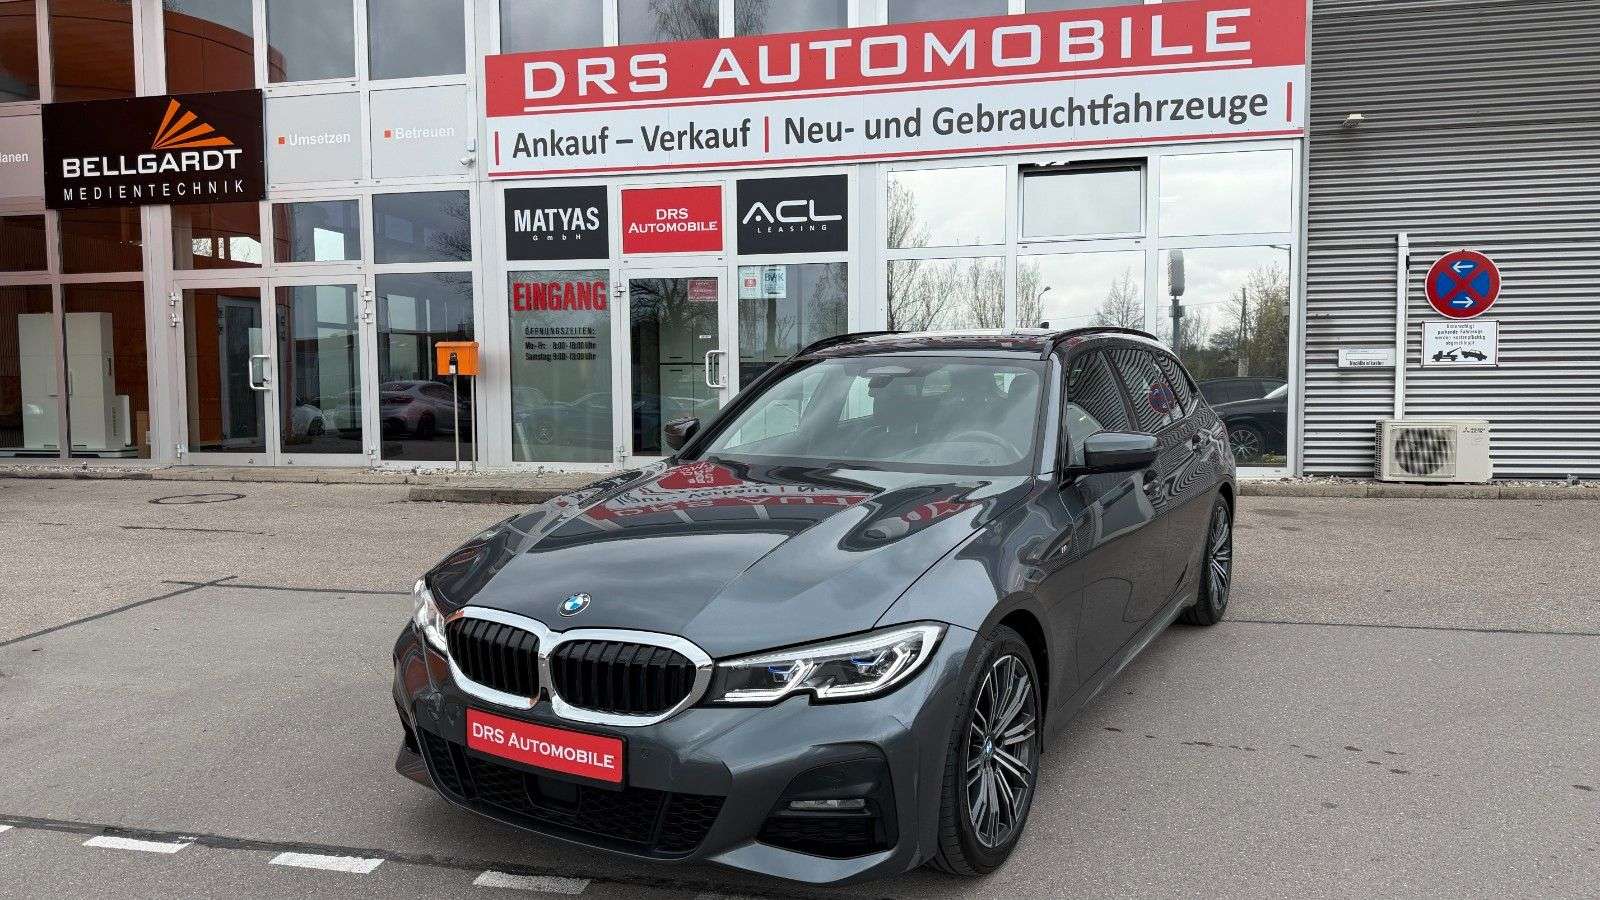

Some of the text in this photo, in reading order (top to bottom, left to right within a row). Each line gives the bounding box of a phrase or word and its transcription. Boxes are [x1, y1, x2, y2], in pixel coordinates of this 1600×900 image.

[524, 8, 1251, 100] DRS AUTOMOBILE
[395, 126, 455, 140] Betreuen
[512, 126, 609, 158] Ankauf
[640, 118, 751, 152] Verkauf
[783, 116, 855, 145] Neu-
[864, 107, 921, 140] und
[932, 92, 1268, 136] Gebrauchtfahrzeuge
[288, 132, 351, 146] Umsetzen
[62, 149, 243, 178] BELLGARDT
[63, 179, 244, 201] MEDIENTECHNIK
[514, 207, 600, 232] MATYAS
[656, 208, 689, 221] DRS
[742, 199, 843, 225] ACL
[628, 221, 718, 234] AUTOMOBILE
[757, 224, 827, 234] LEASING
[512, 280, 607, 312] EINGANG
[472, 722, 615, 769] DRS AUTOMOBILE
